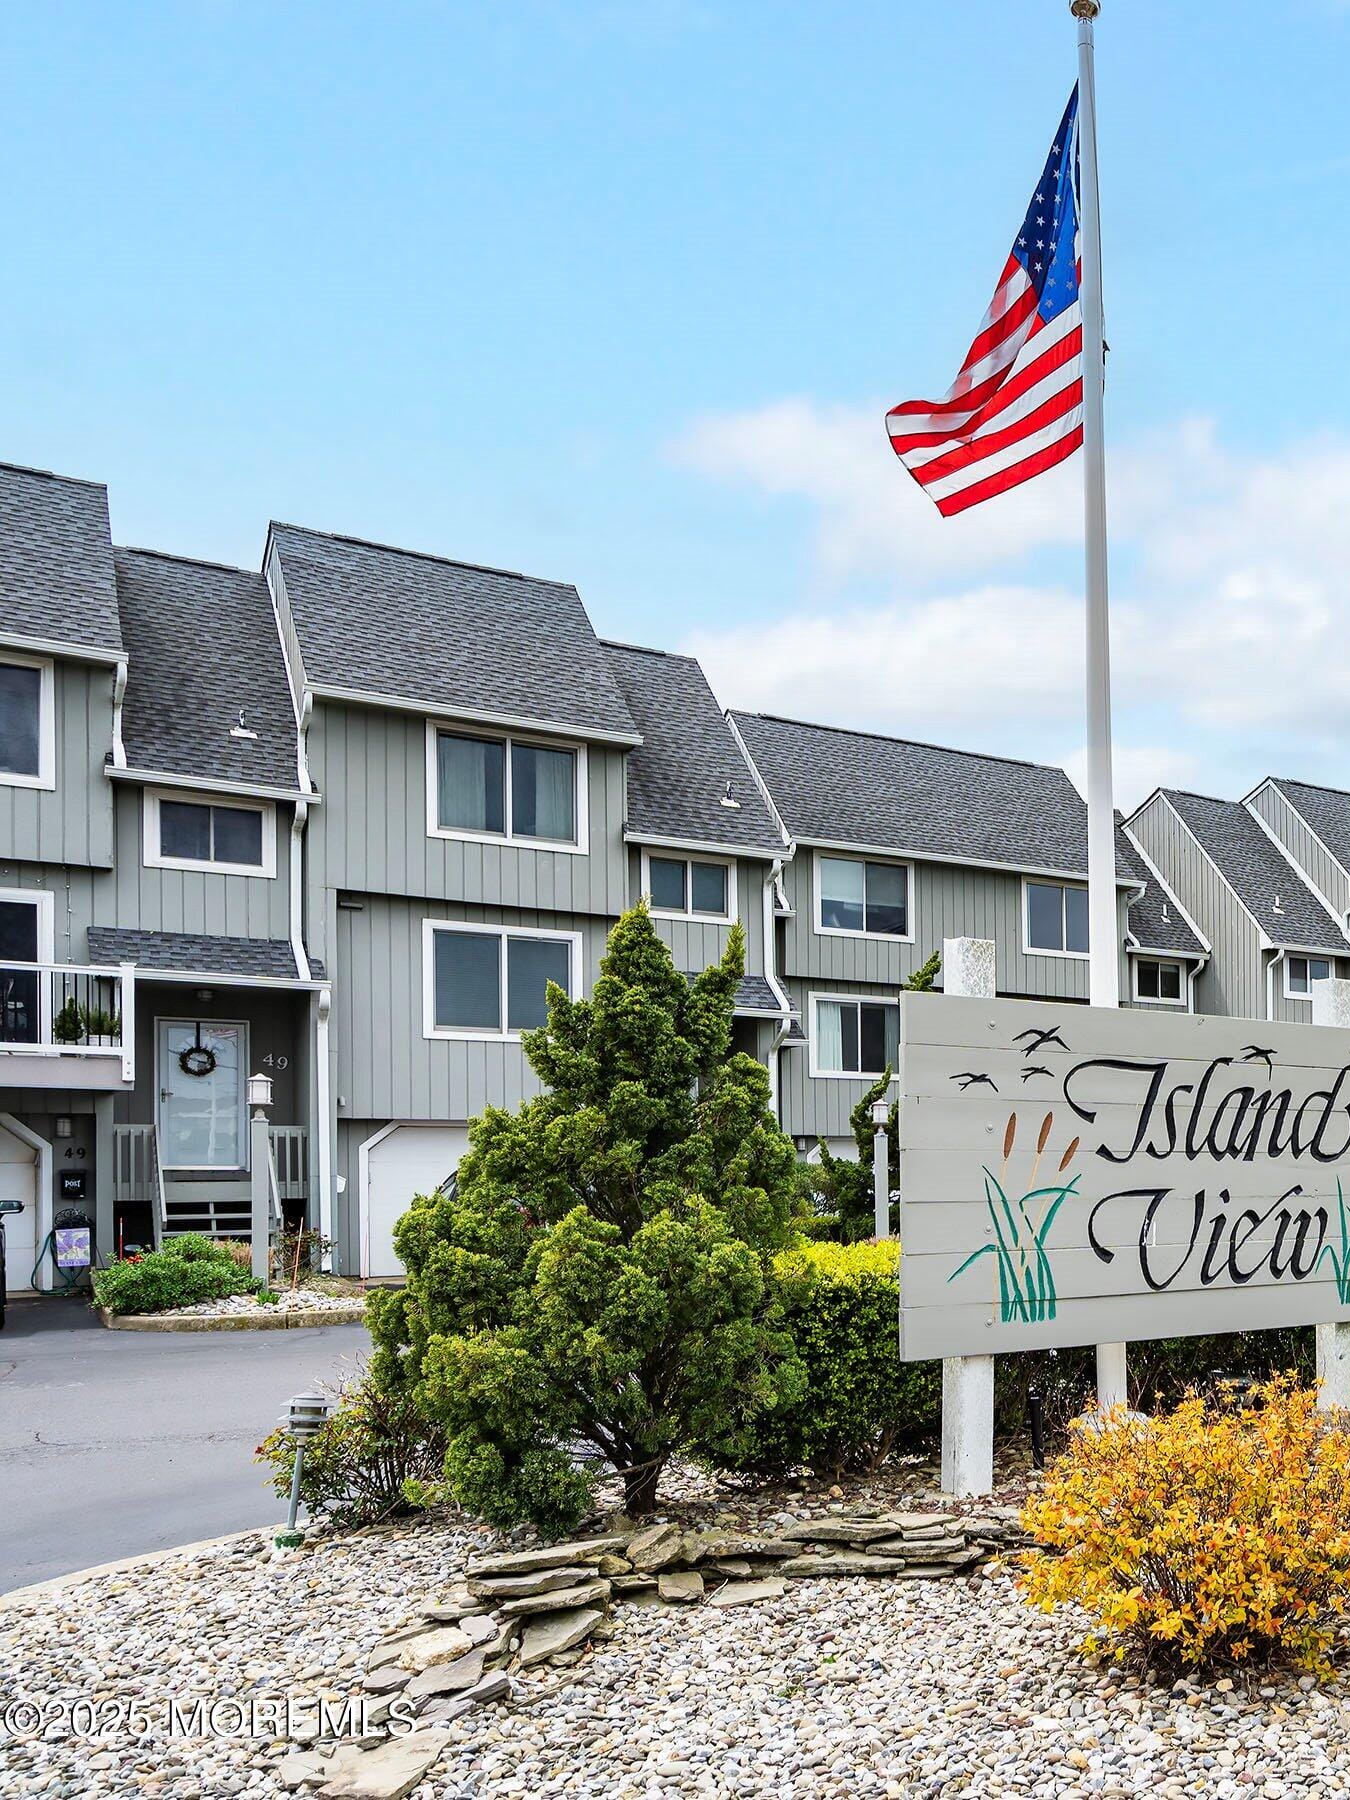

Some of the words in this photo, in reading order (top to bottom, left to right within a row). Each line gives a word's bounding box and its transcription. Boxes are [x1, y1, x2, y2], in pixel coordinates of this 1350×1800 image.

[262, 1053, 288, 1070] 49
[64, 1147, 86, 1159] 49
[64, 1180, 80, 1188] POST
[1088, 1185, 1329, 1291] View
